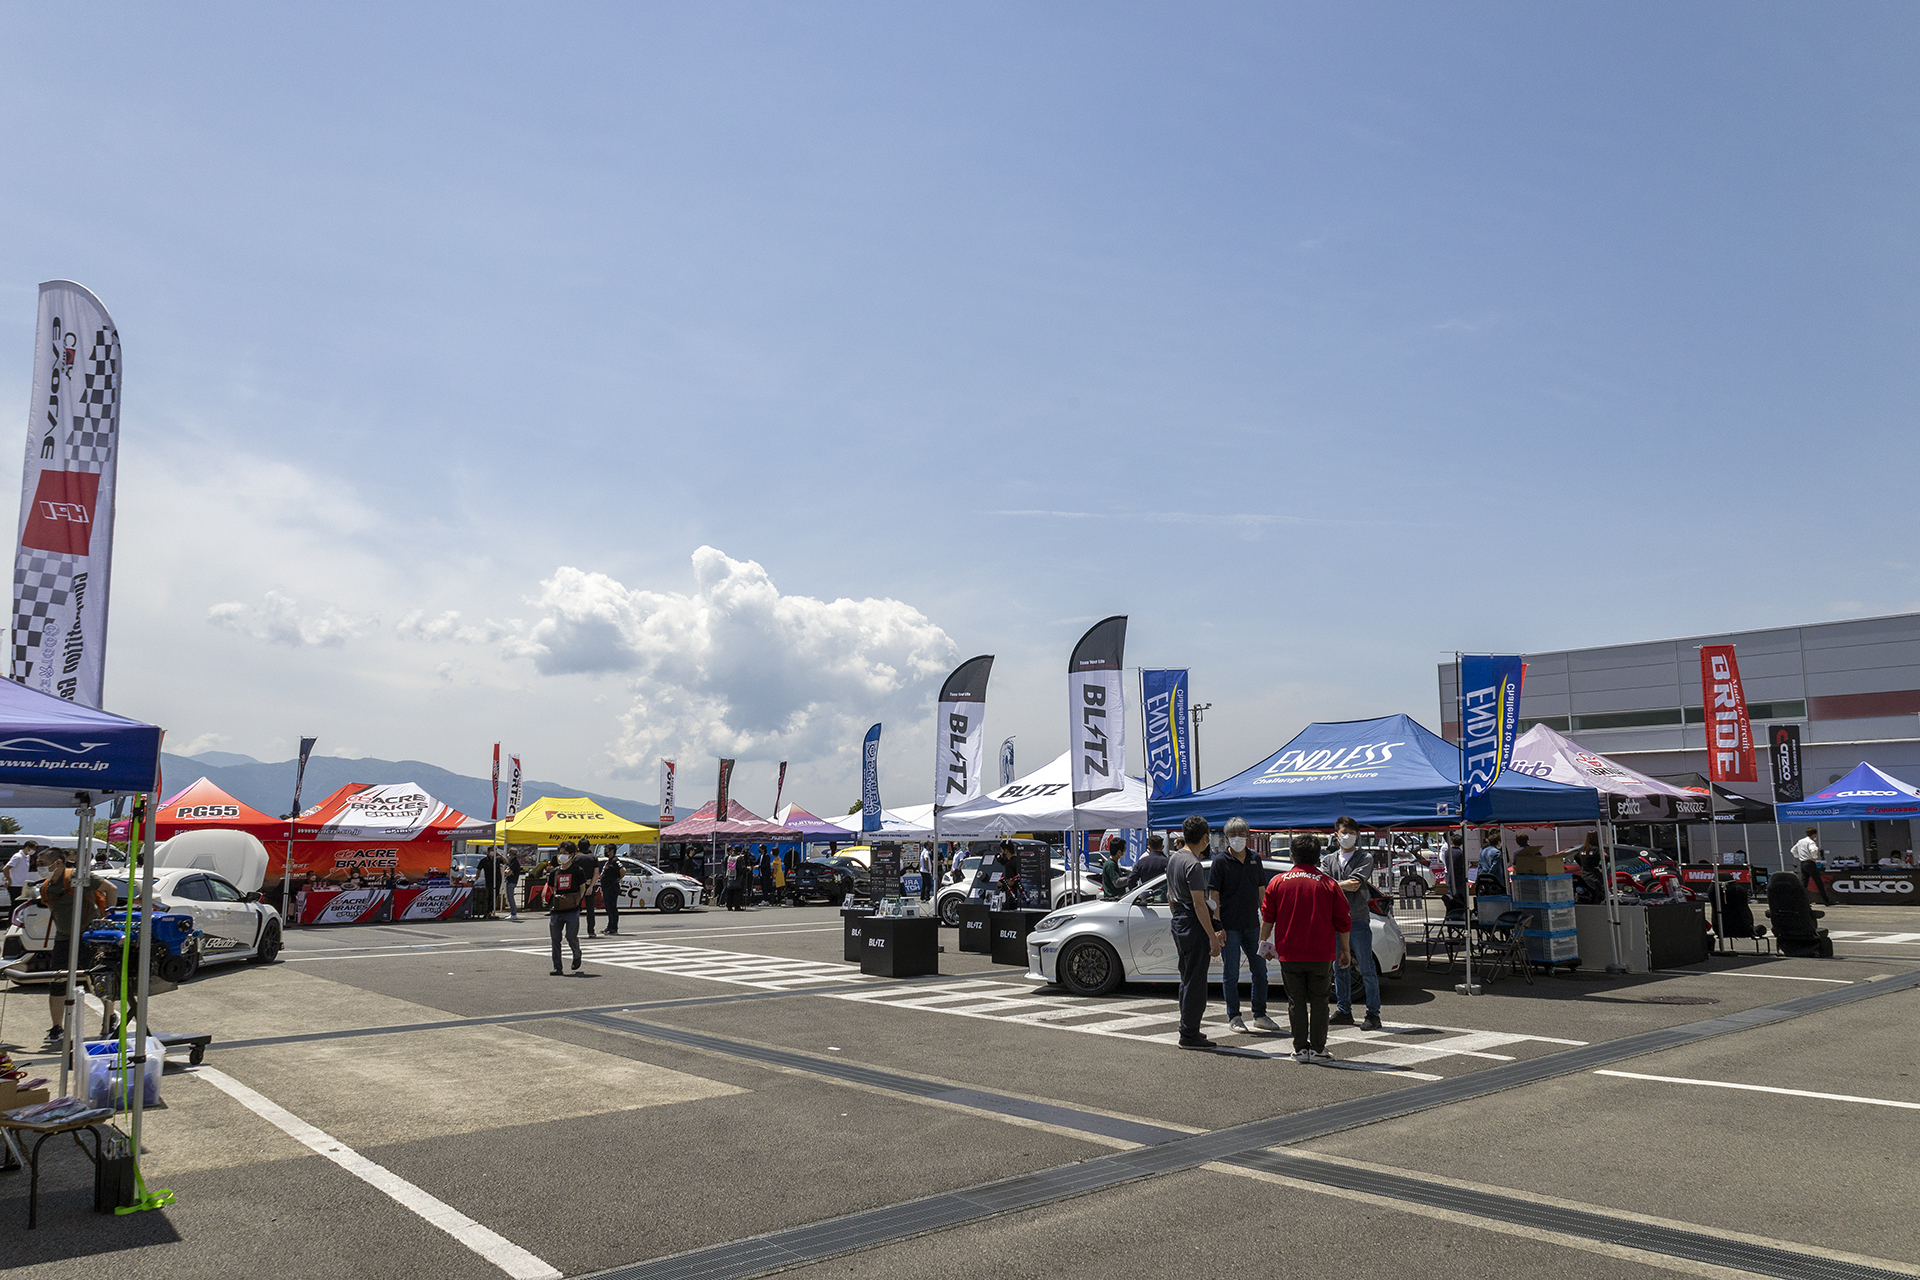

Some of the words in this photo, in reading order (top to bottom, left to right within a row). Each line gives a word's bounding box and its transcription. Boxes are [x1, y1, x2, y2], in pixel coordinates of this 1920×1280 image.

[1731, 678, 1741, 704] Made
[1738, 706, 1744, 715] in
[1710, 653, 1740, 775] BRIDE
[1083, 683, 1110, 777] BLITZ
[946, 713, 968, 795] BLITZ
[1264, 741, 1406, 774] ENDLESS
[0, 759, 110, 772] www.hpi.co.jp
[1252, 777, 1304, 785] Challenge
[1340, 772, 1379, 780] Future
[997, 783, 1070, 799] BLITZ
[371, 793, 427, 804] ACRE
[176, 804, 240, 819] PG55
[351, 801, 429, 811] BRAKES
[1675, 801, 1707, 813] BRIDE
[1786, 808, 1840, 816] www.cusco.co.jp
[353, 848, 398, 858] ACRE
[335, 858, 398, 869] BRAKES
[1281, 871, 1323, 882] Kissmark
[1832, 880, 1914, 893] CUSCO
[966, 921, 983, 930] BLITZ
[1000, 929, 1017, 939] BLITZ
[868, 938, 885, 948] BLITZ
